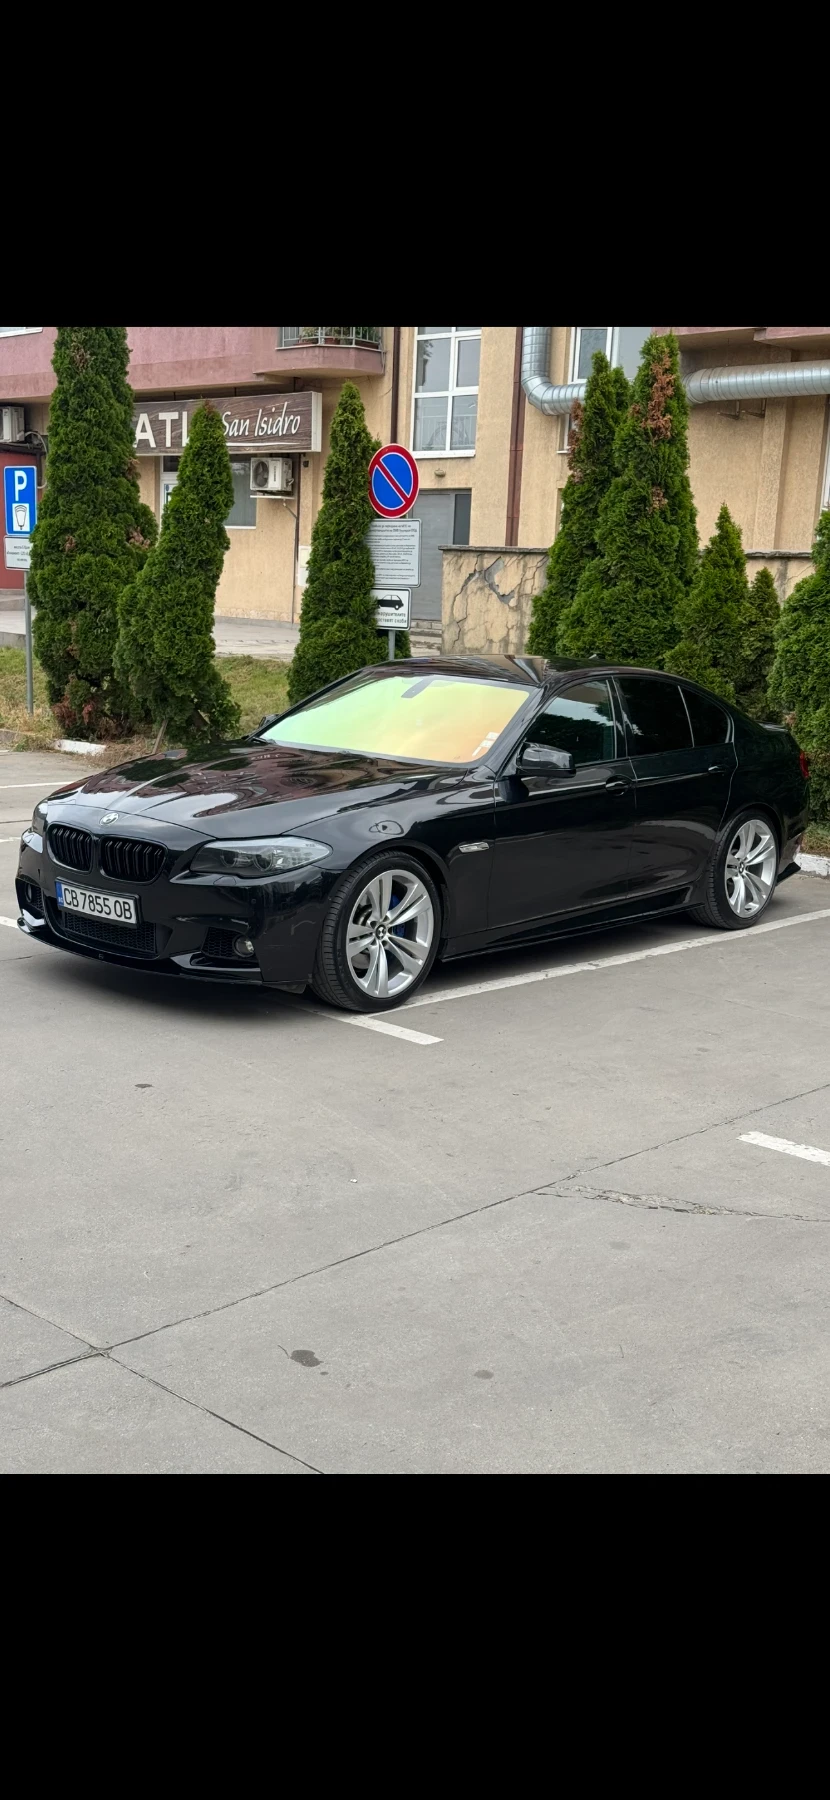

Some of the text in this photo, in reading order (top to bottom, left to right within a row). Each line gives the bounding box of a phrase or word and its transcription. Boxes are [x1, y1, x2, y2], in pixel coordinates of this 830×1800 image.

[221, 401, 301, 437] San Isidro
[14, 470, 27, 502] P
[63, 887, 79, 908] CB
[80, 891, 112, 916] 7855
